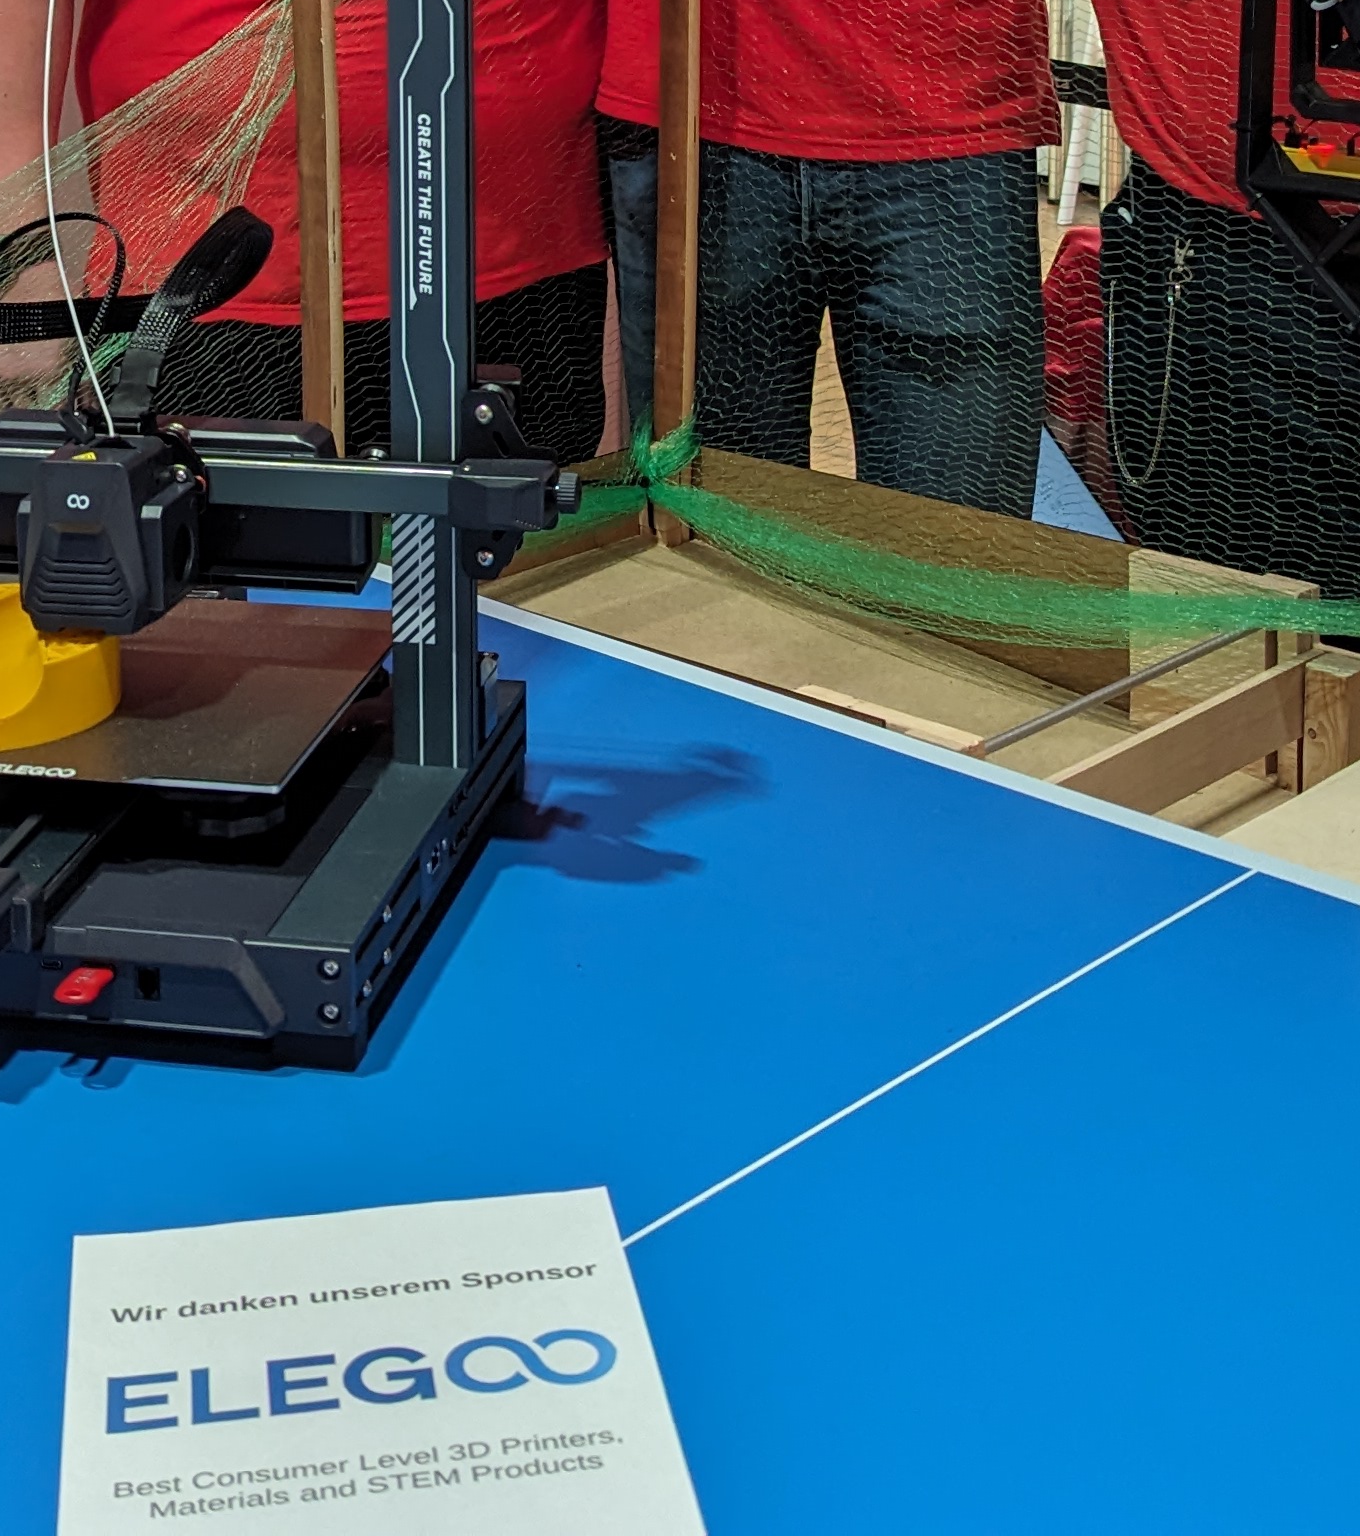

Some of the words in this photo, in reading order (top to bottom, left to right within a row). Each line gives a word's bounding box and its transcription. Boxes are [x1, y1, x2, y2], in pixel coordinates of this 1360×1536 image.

[417, 114, 431, 181] CREATE
[418, 186, 432, 221] THE
[418, 225, 432, 295] FUTURE
[110, 1303, 168, 1324] Wir
[177, 1290, 298, 1319] danken
[310, 1274, 451, 1305] unserem
[461, 1260, 597, 1289] Sponsor
[105, 1328, 618, 1435] ELEGOO
[113, 1475, 182, 1499] Best
[192, 1455, 349, 1492] Consumer
[360, 1445, 440, 1471] Level
[449, 1441, 491, 1463] 3D
[148, 1486, 290, 1520] Materials
[301, 1478, 356, 1503] and
[368, 1466, 461, 1495] STEM
[473, 1452, 604, 1484] Products
